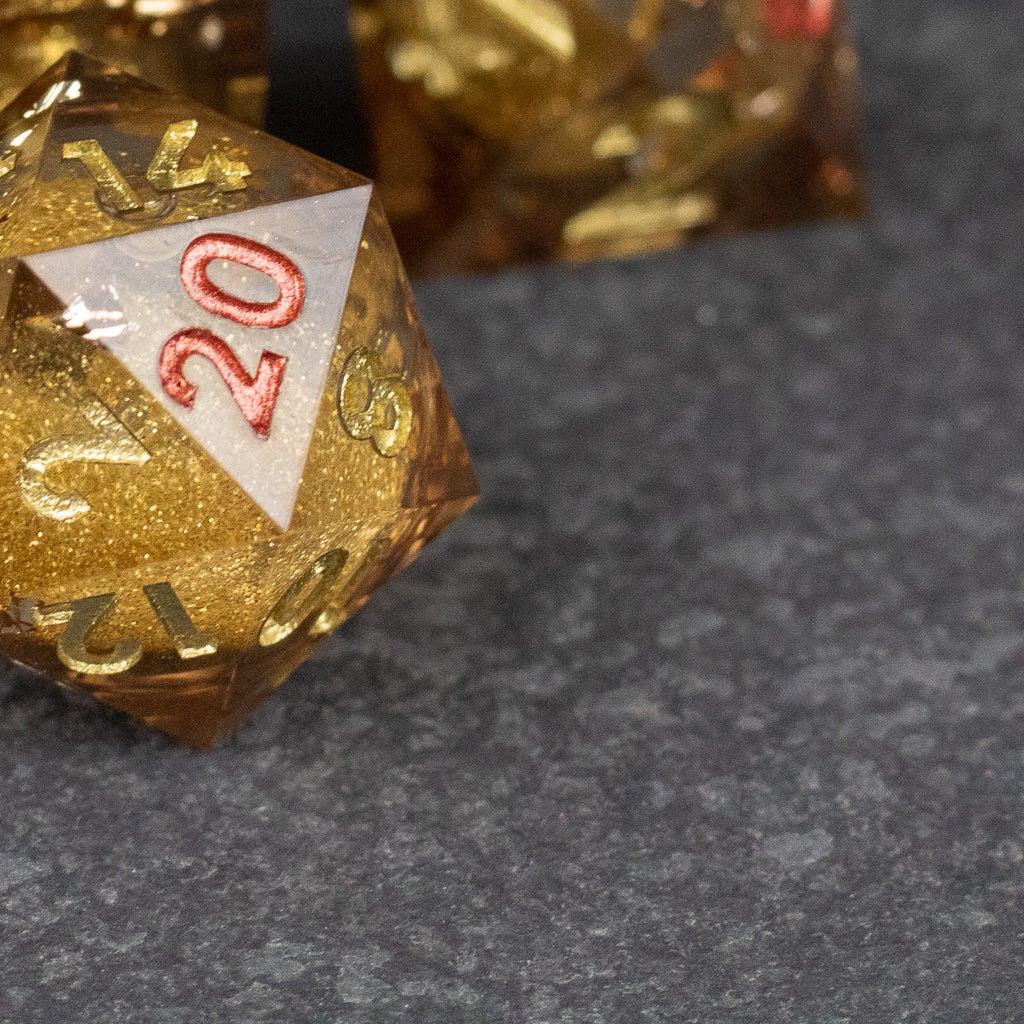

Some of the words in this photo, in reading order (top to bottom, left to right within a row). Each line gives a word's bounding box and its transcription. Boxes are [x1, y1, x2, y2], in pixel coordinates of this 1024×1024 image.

[62, 118, 252, 213] 14
[158, 232, 307, 442] 20
[16, 392, 154, 525] 2
[32, 580, 220, 676] 12
